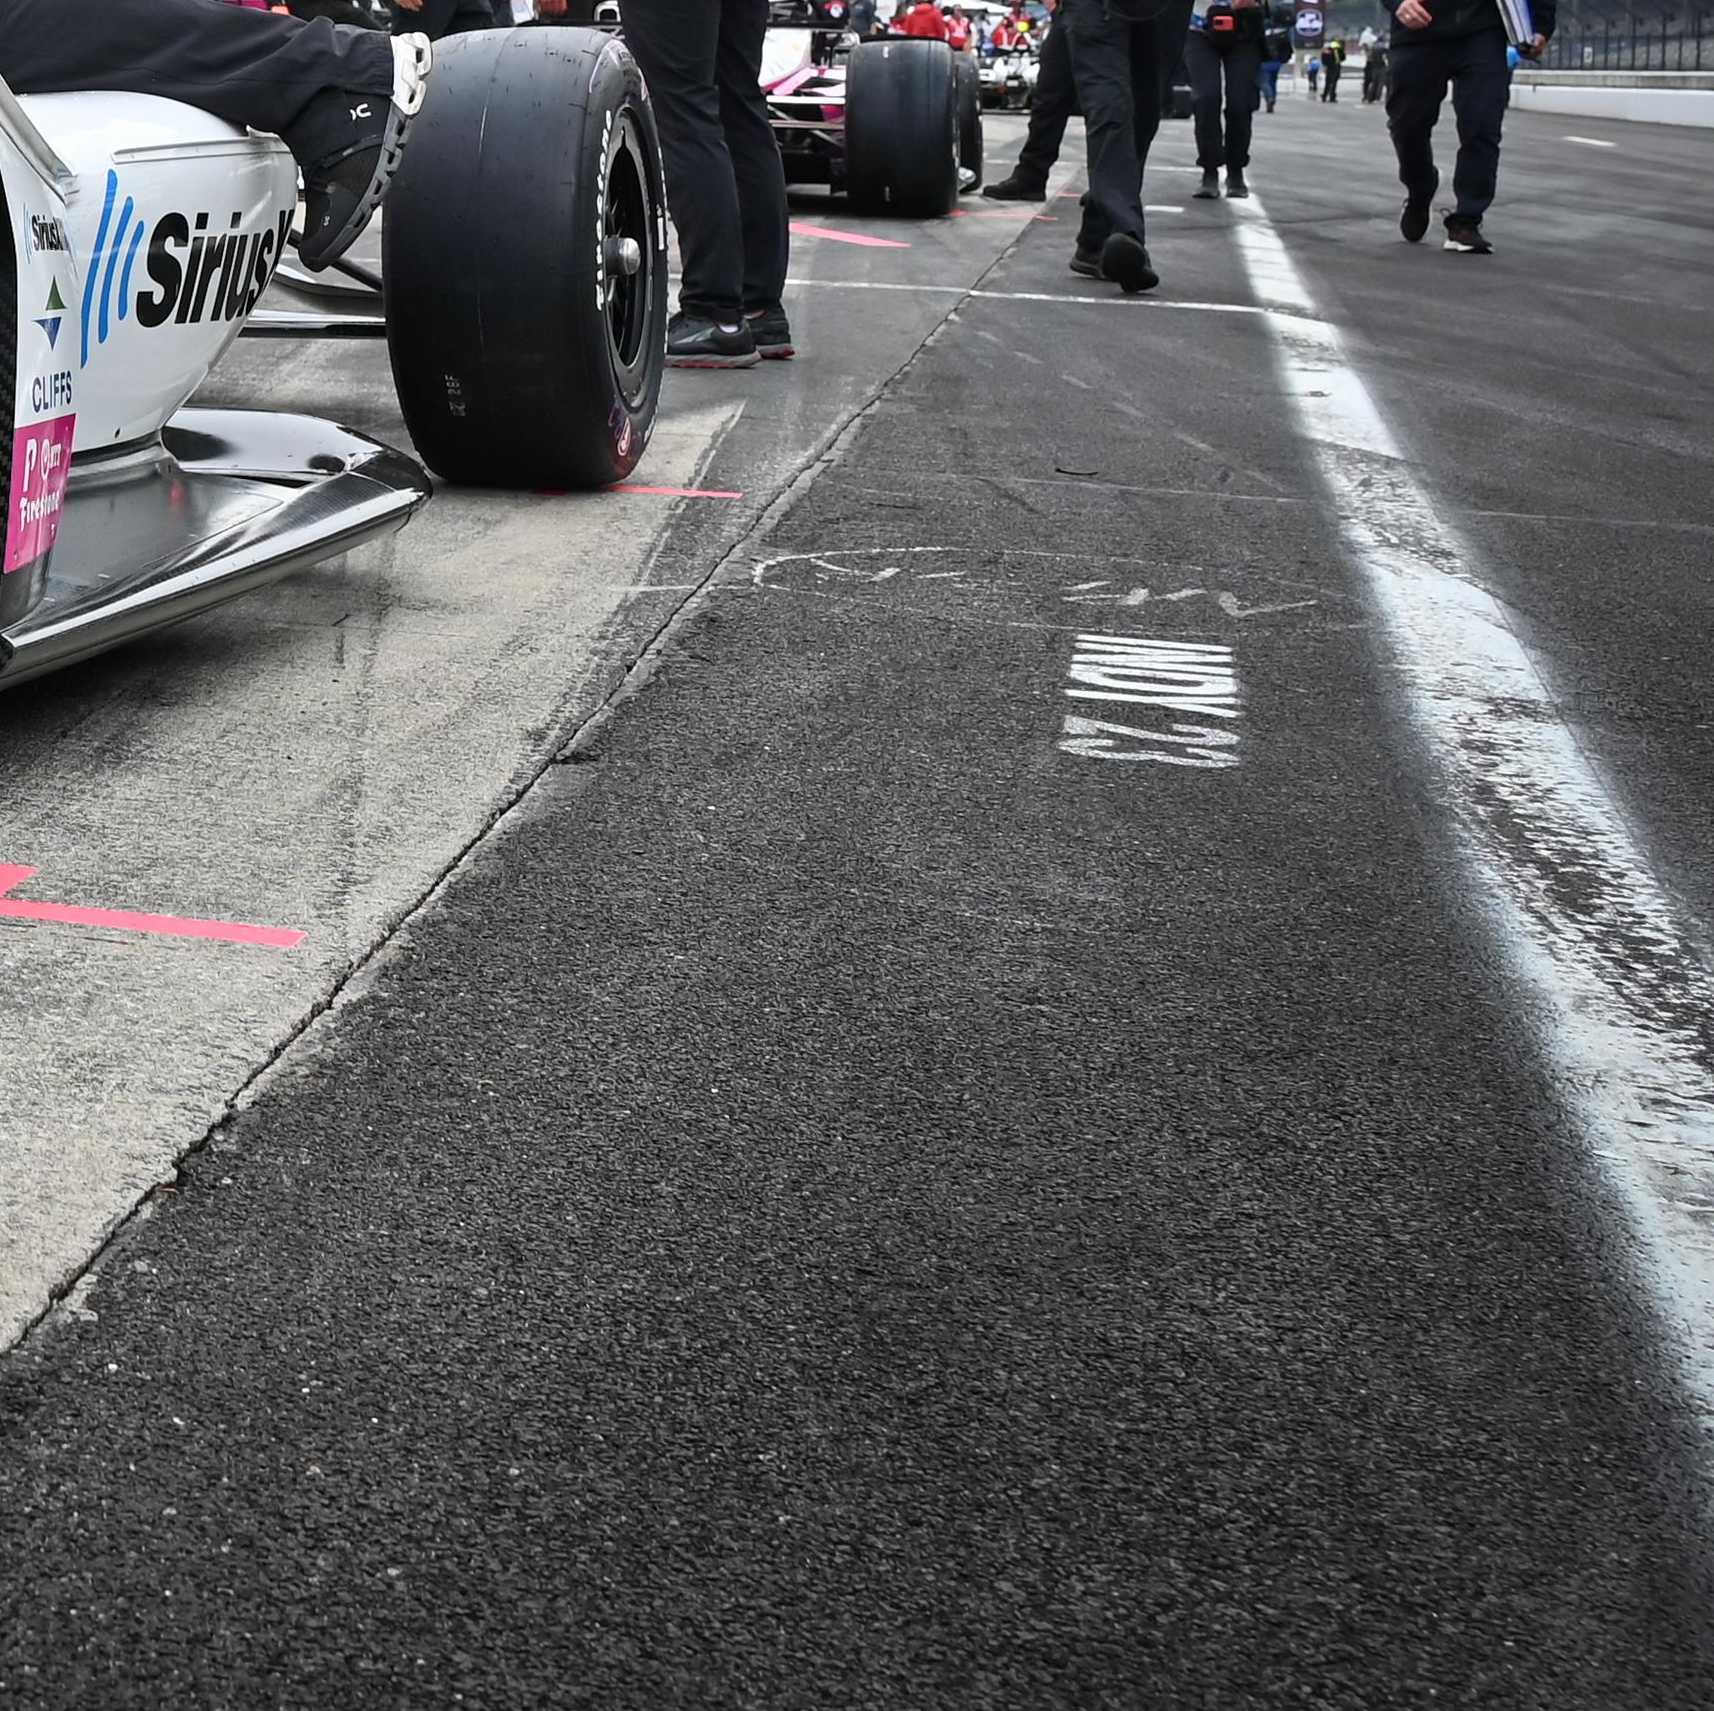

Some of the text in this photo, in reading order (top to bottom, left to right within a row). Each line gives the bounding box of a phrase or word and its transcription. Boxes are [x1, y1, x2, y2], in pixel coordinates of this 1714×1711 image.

[32, 370, 72, 414] CLIFFS
[19, 489, 60, 533] Firestone
[1064, 633, 1244, 717] INDY
